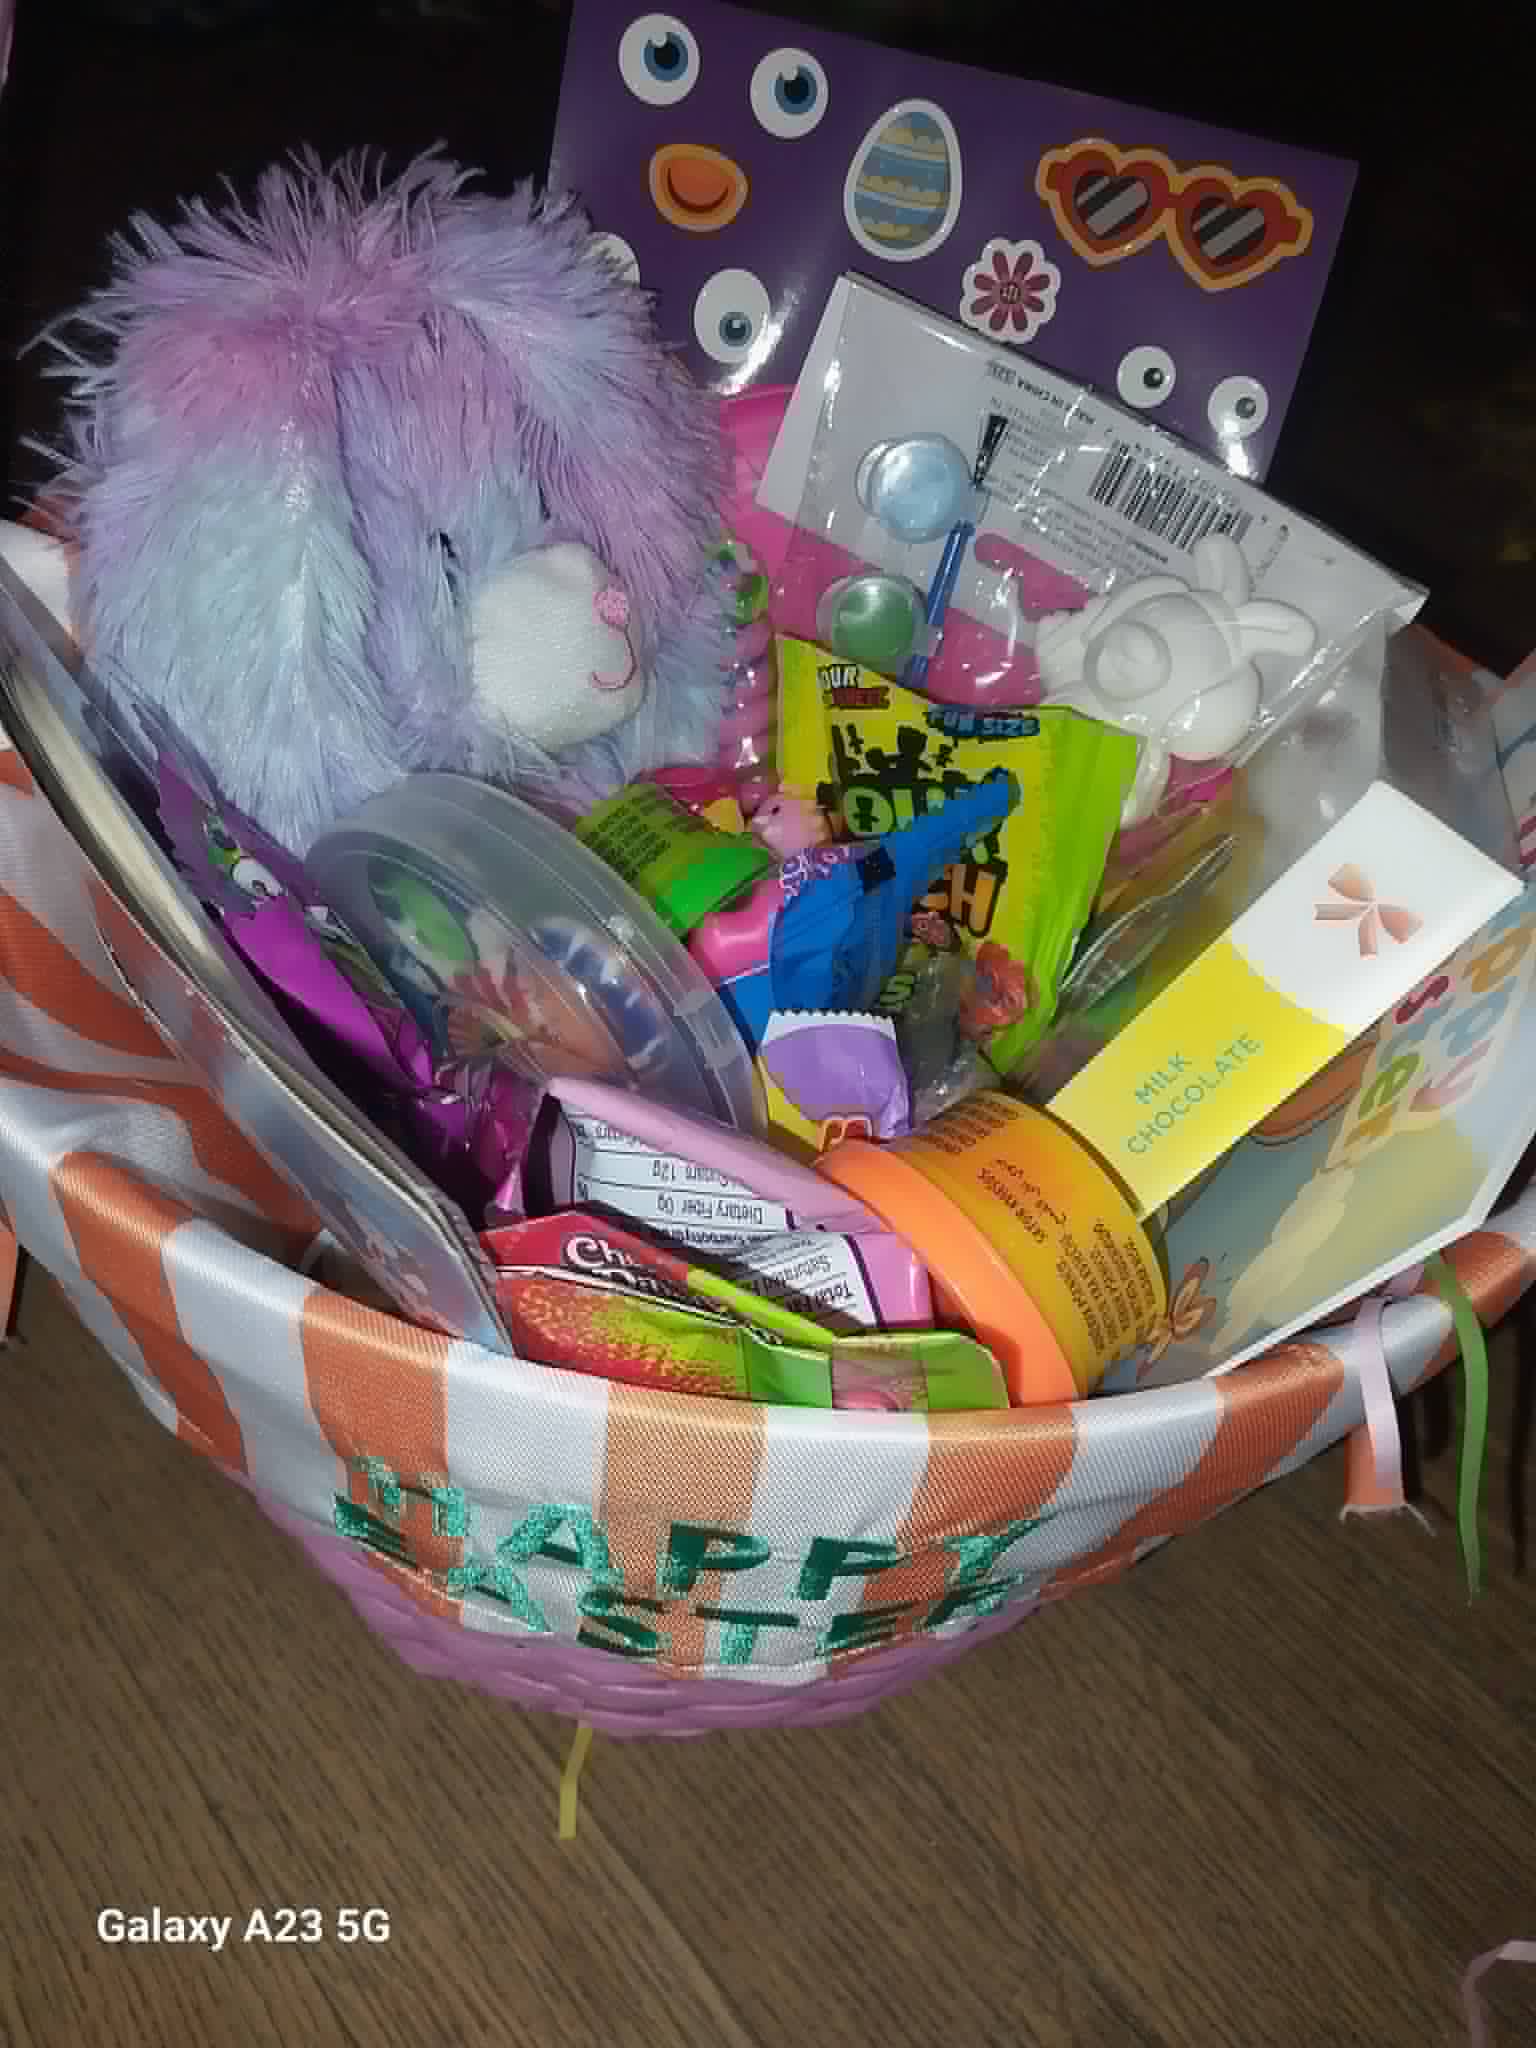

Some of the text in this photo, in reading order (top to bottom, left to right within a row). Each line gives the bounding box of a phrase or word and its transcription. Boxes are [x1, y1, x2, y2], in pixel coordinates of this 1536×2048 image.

[1127, 1032, 1263, 1153] CHOCOLATE
[1132, 1050, 1193, 1105] MILK
[681, 1198, 713, 1220] Fiber
[716, 1199, 764, 1225] Dietary
[762, 1255, 832, 1291] Saturated
[813, 1279, 855, 1307] Total
[350, 1455, 1053, 1602] HAPPY
